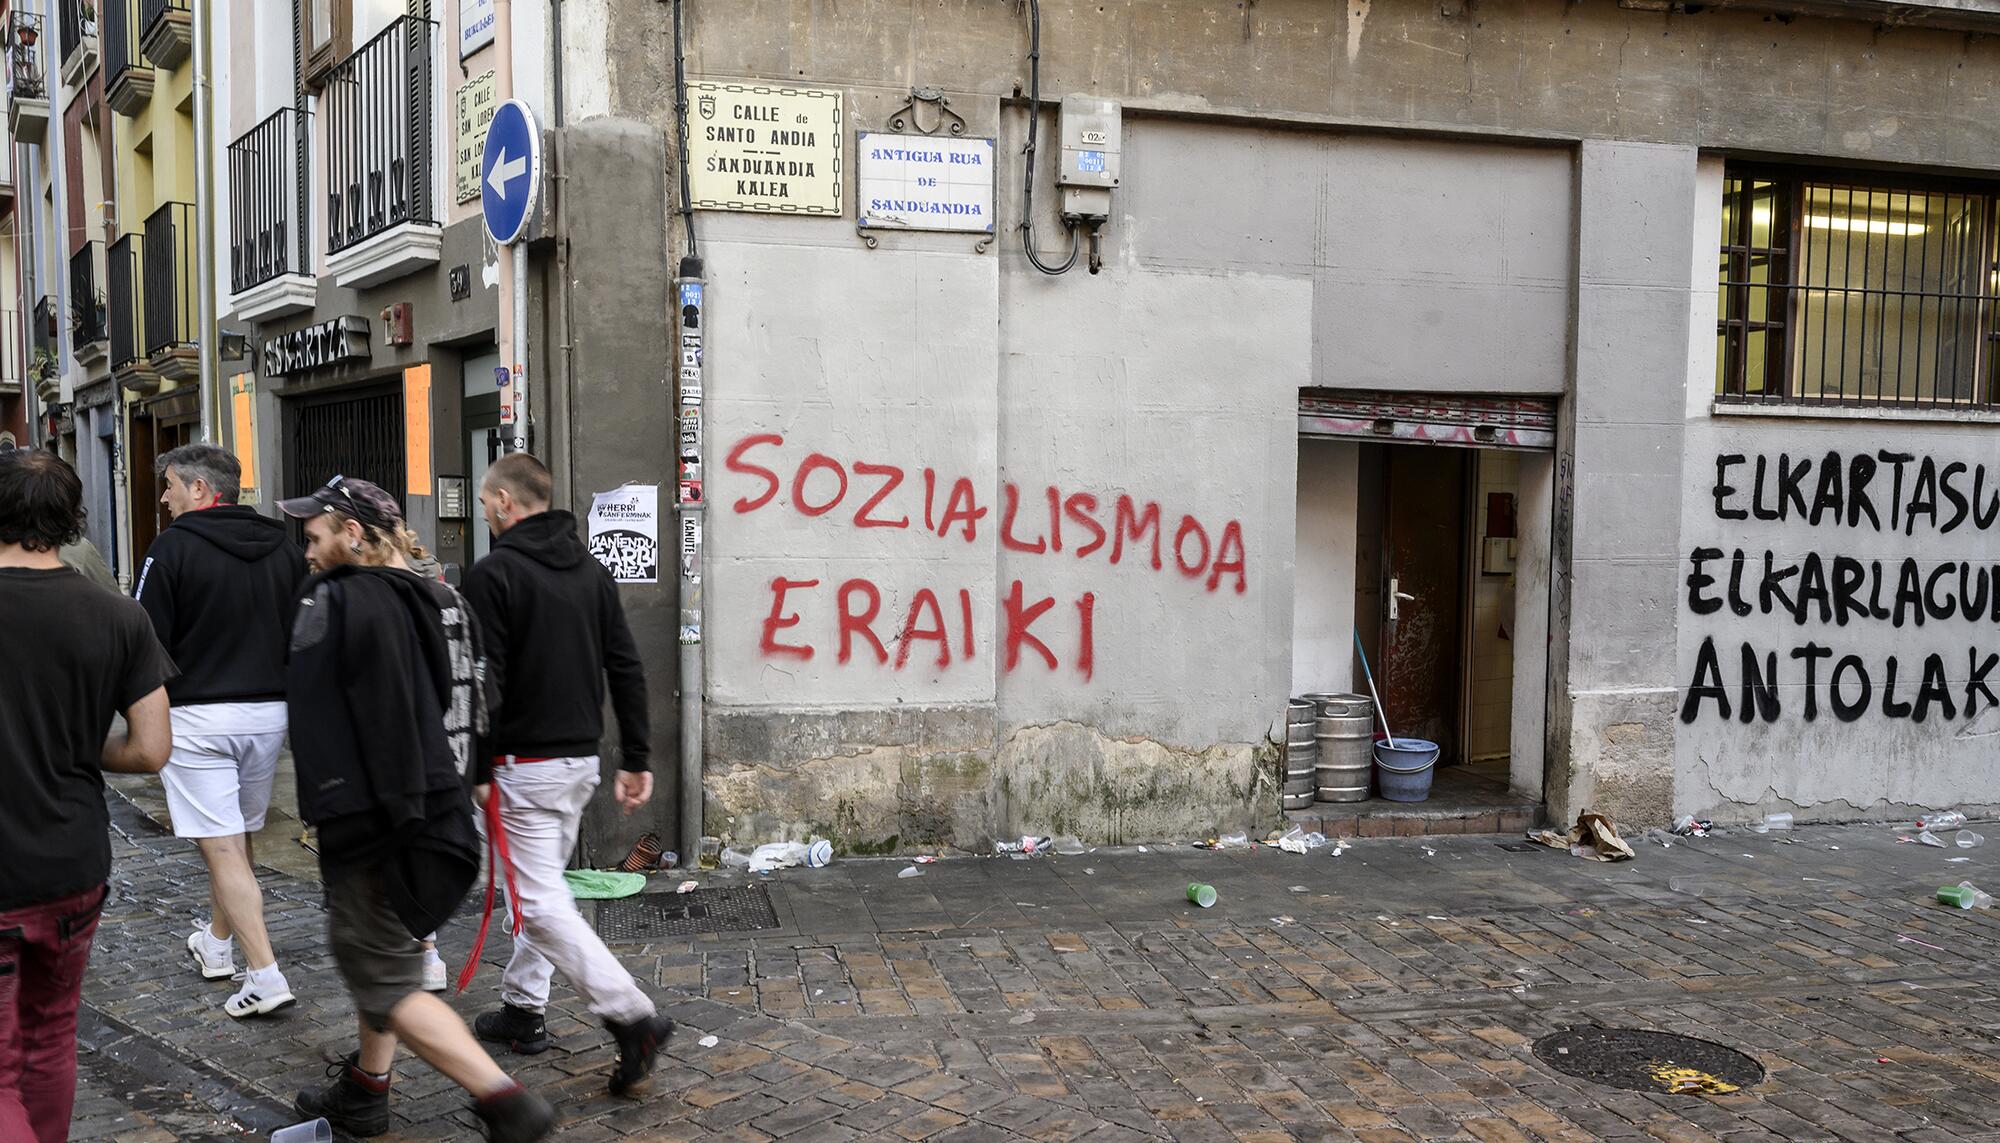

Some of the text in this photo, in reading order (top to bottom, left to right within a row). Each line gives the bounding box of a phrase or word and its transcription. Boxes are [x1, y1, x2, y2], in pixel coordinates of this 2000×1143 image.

[474, 86, 490, 107] CALLE
[461, 106, 496, 136] SAN LOREN
[733, 104, 808, 124] CALLE de
[706, 126, 816, 147] SANTO ANDIA
[1088, 132, 1099, 141] 02
[460, 140, 485, 165] SAN LOR
[871, 148, 982, 165] ANTIGUA RUA
[706, 156, 816, 177] SANDUANDIA
[736, 179, 789, 197] KALEA
[917, 177, 937, 187] DE
[871, 198, 982, 215] SANDUANDIA
[264, 317, 349, 377] ASKARTZA
[1712, 449, 2000, 536] ELKARTASU
[607, 503, 636, 512] HERRI
[726, 433, 1248, 595] SOZIALISMOA
[590, 533, 655, 549] MANTENDU
[684, 519, 695, 553] KANUTE
[760, 577, 1096, 685] ERAIKI
[1681, 635, 2000, 724] ANTOLAK
